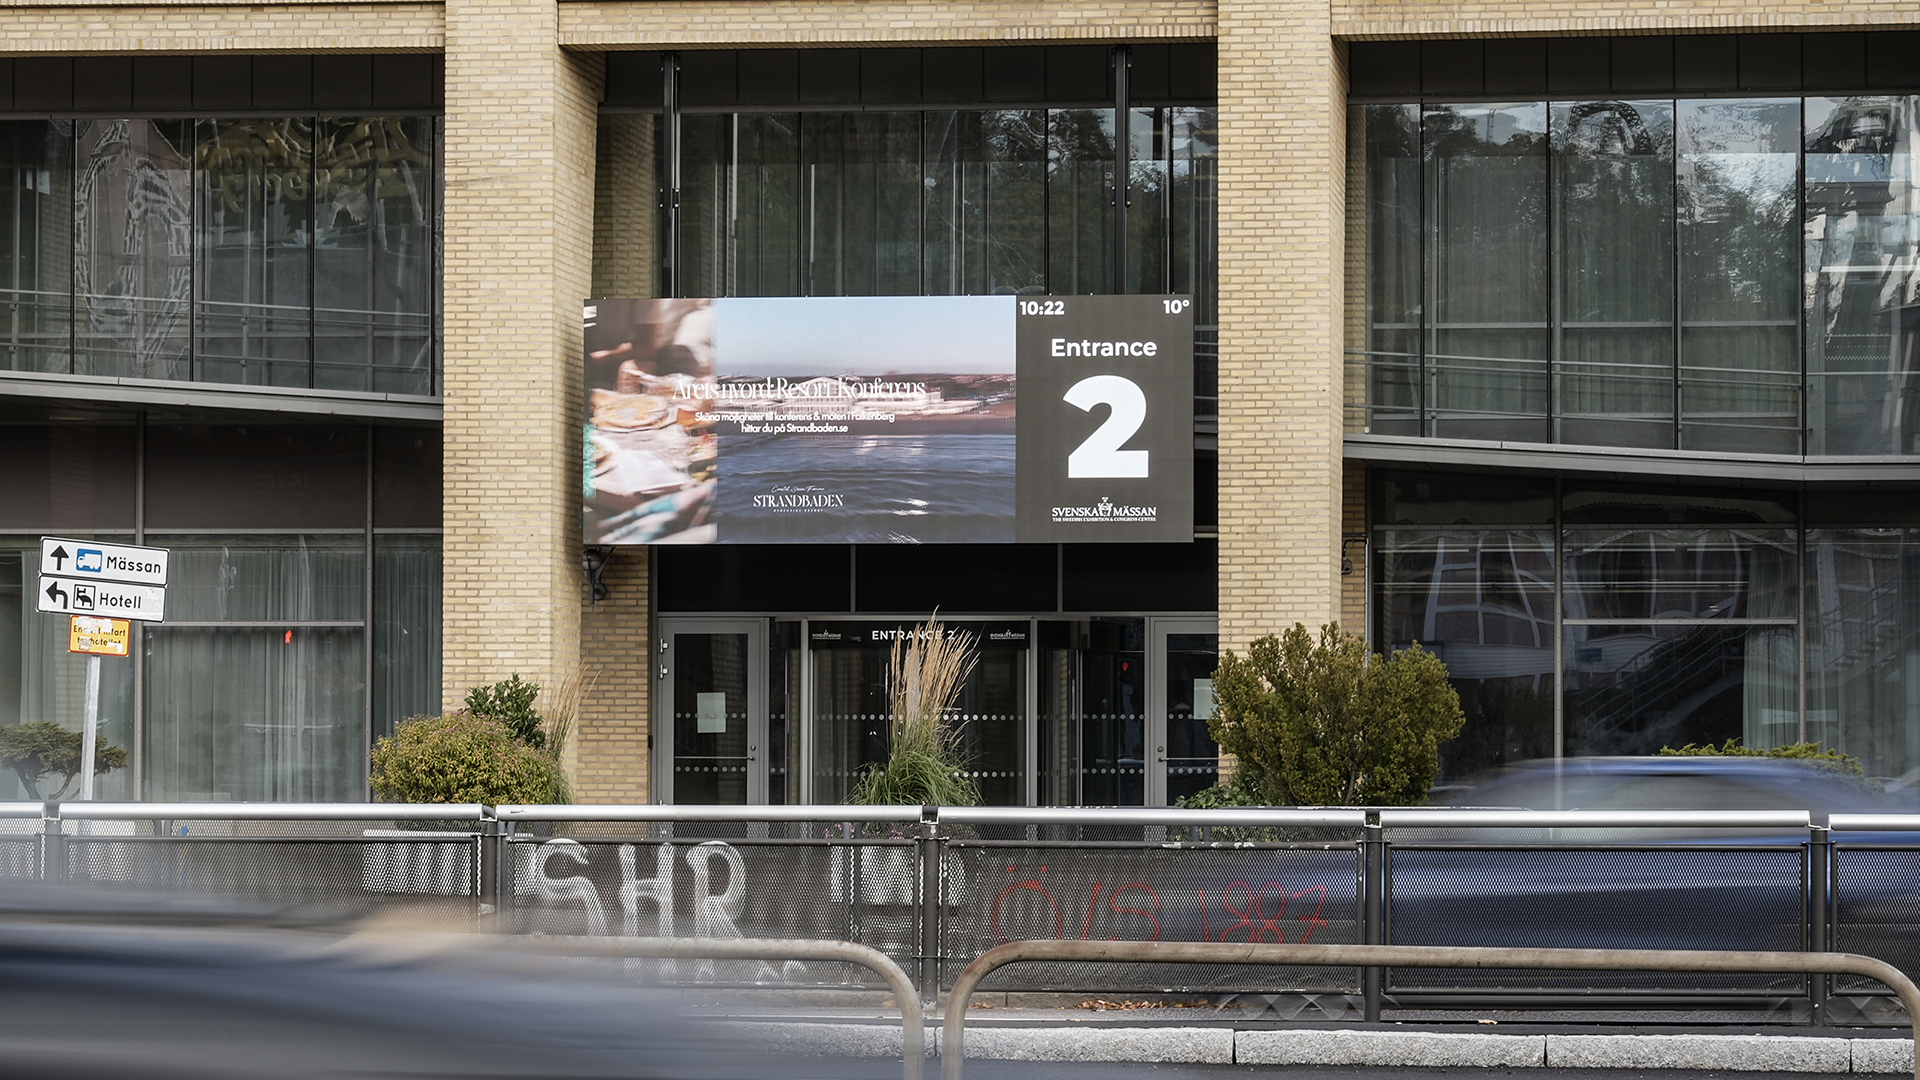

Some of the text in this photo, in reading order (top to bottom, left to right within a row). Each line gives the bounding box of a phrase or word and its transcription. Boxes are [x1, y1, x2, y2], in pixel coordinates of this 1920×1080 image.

[1019, 300, 1065, 316] 10:22
[1163, 299, 1190, 315] 10°
[1051, 338, 1158, 357] Entrance
[672, 374, 720, 400] Årets
[721, 376, 775, 402] nyord:
[837, 377, 927, 399] Konferens
[695, 411, 720, 422] Sköna
[721, 411, 764, 424] möjligheter
[765, 410, 774, 421] till
[774, 410, 812, 421] konferens
[813, 411, 821, 421] &
[821, 411, 847, 421] möten
[851, 410, 895, 424] Falkenberg
[741, 422, 849, 436] hittar du på Strandbaden.se
[1062, 374, 1149, 479] 2
[753, 494, 844, 508] STRANDBADEN
[1051, 505, 1156, 517] SVENSKA MÄSSAN
[106, 556, 161, 574] Mässan
[99, 592, 142, 609] Hotell
[947, 629, 955, 640] 2
